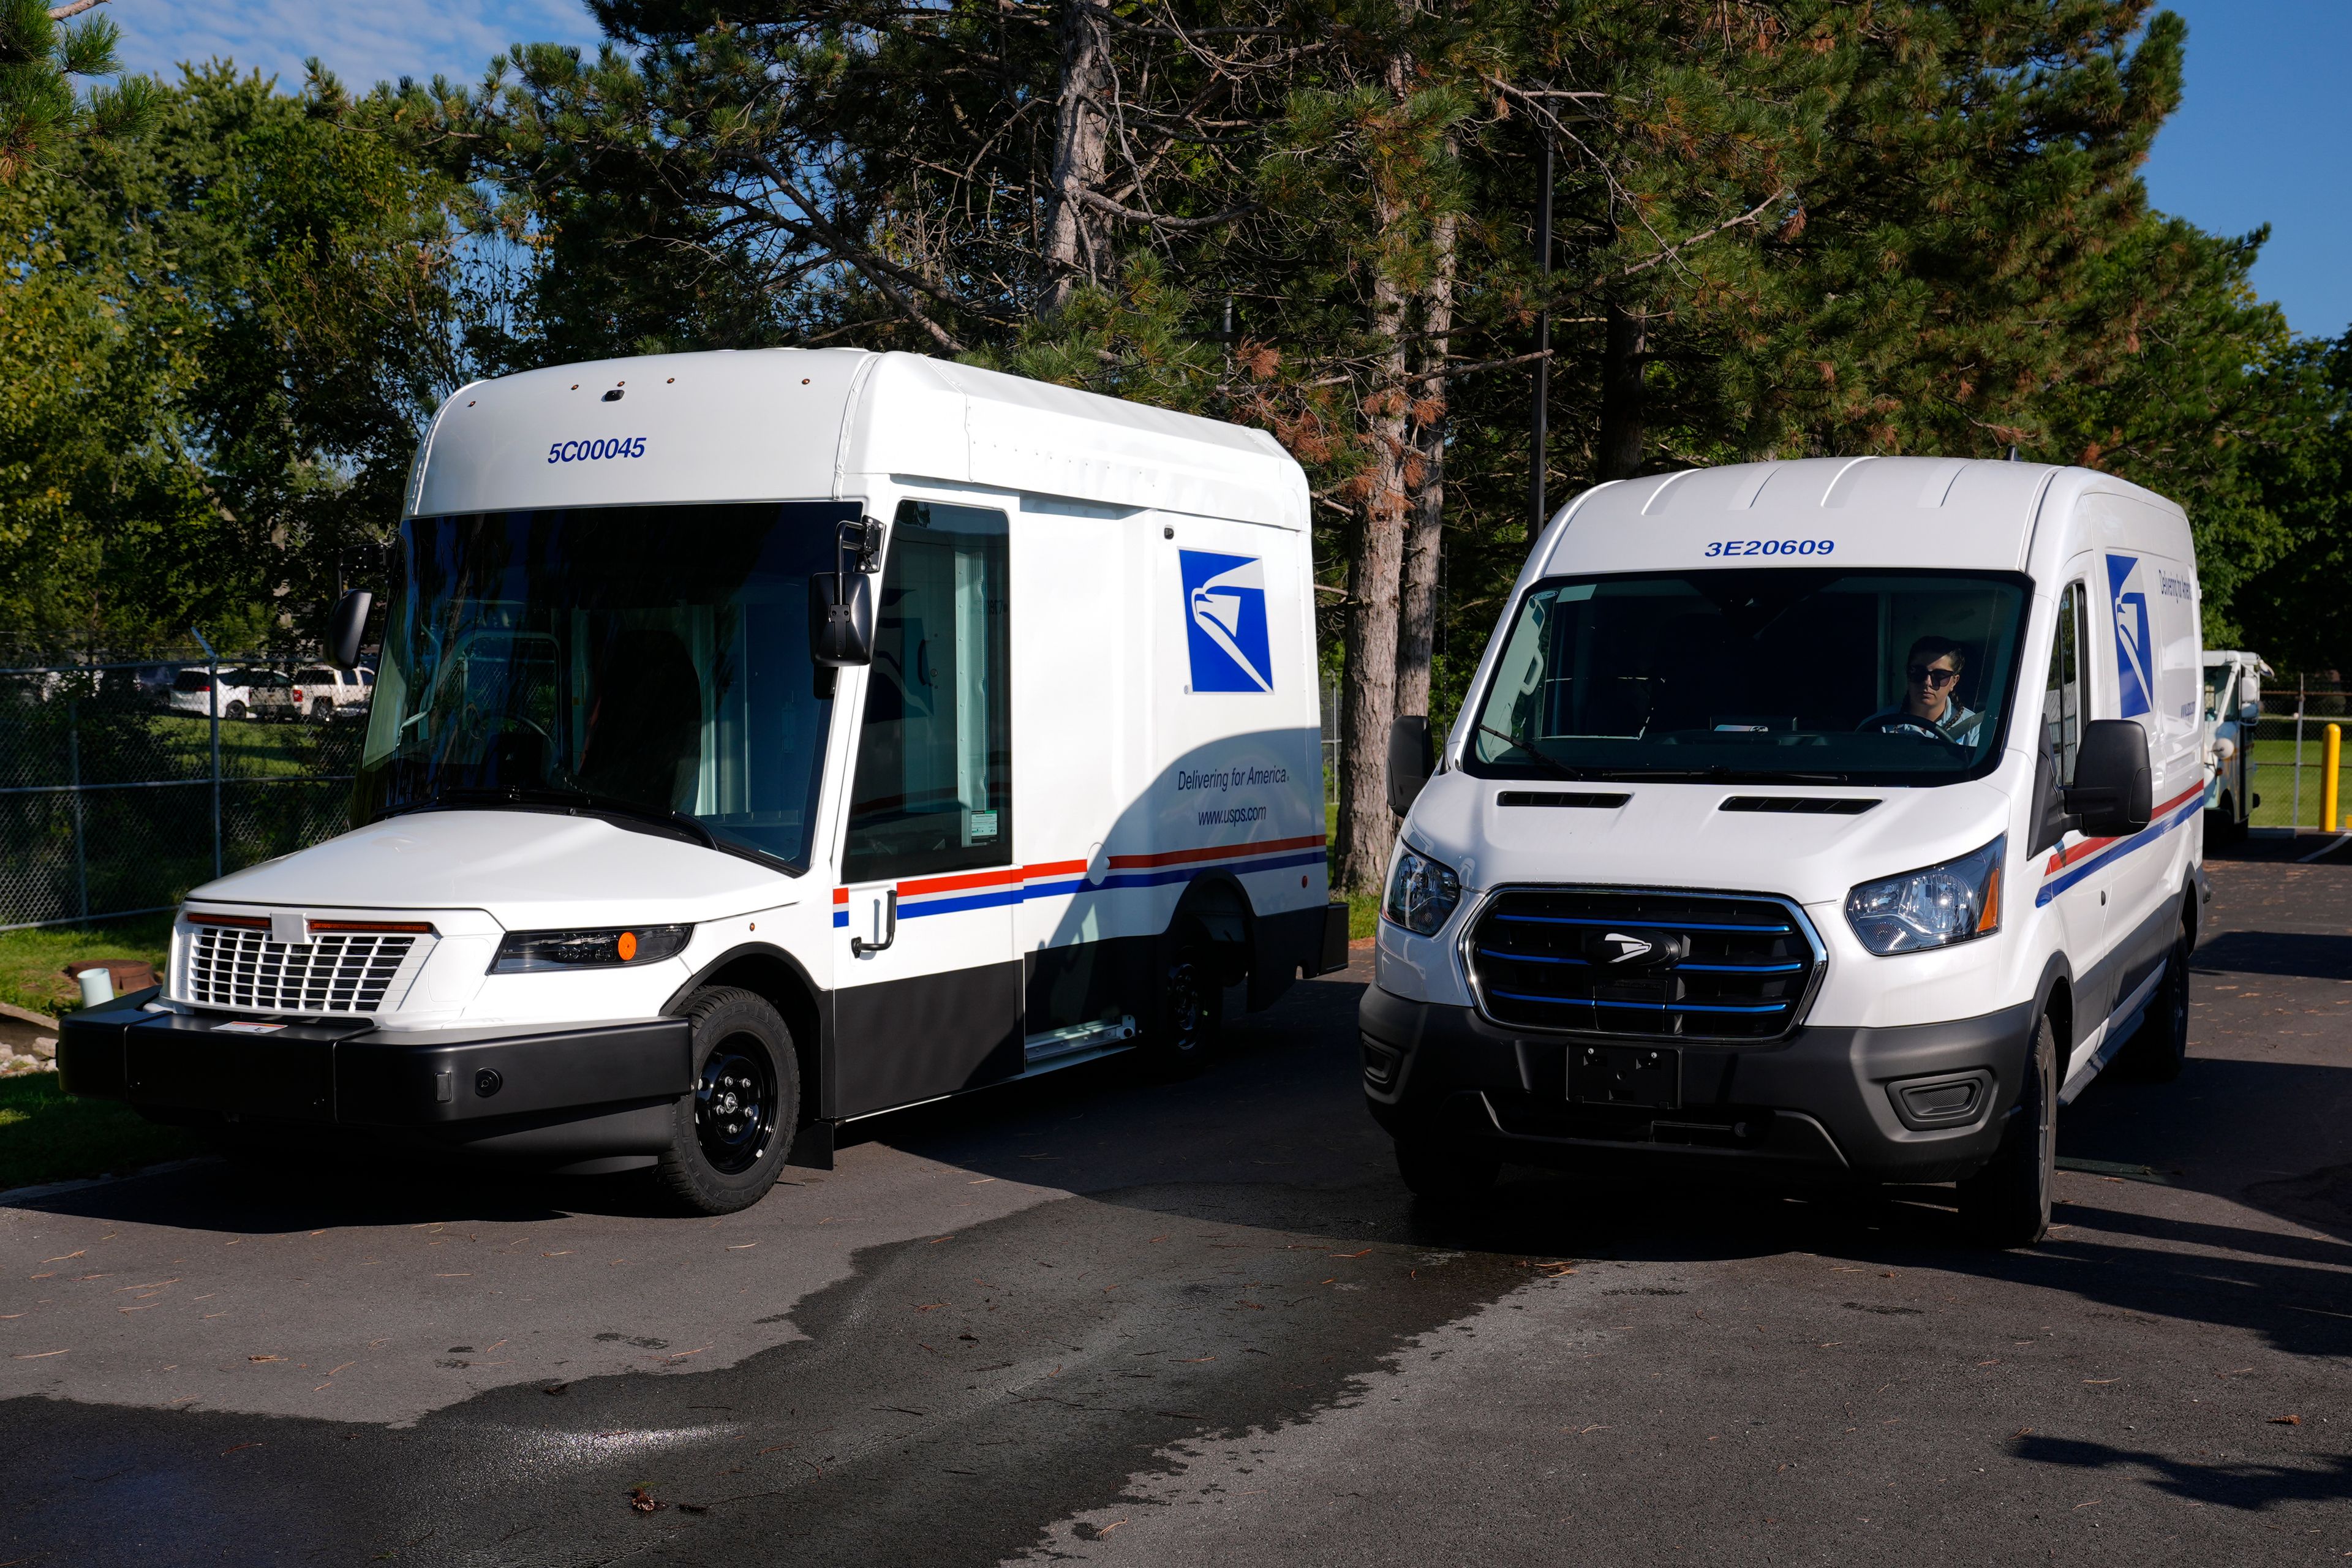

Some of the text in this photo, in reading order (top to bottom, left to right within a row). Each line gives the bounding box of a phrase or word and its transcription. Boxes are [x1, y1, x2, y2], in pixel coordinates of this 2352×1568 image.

[547, 437, 647, 464] 5C00045
[1705, 540, 1834, 557] 3E20609
[1178, 769, 1229, 793] Delivering
[1231, 767, 1246, 786] for
[1198, 805, 1267, 827] www.usps.com
